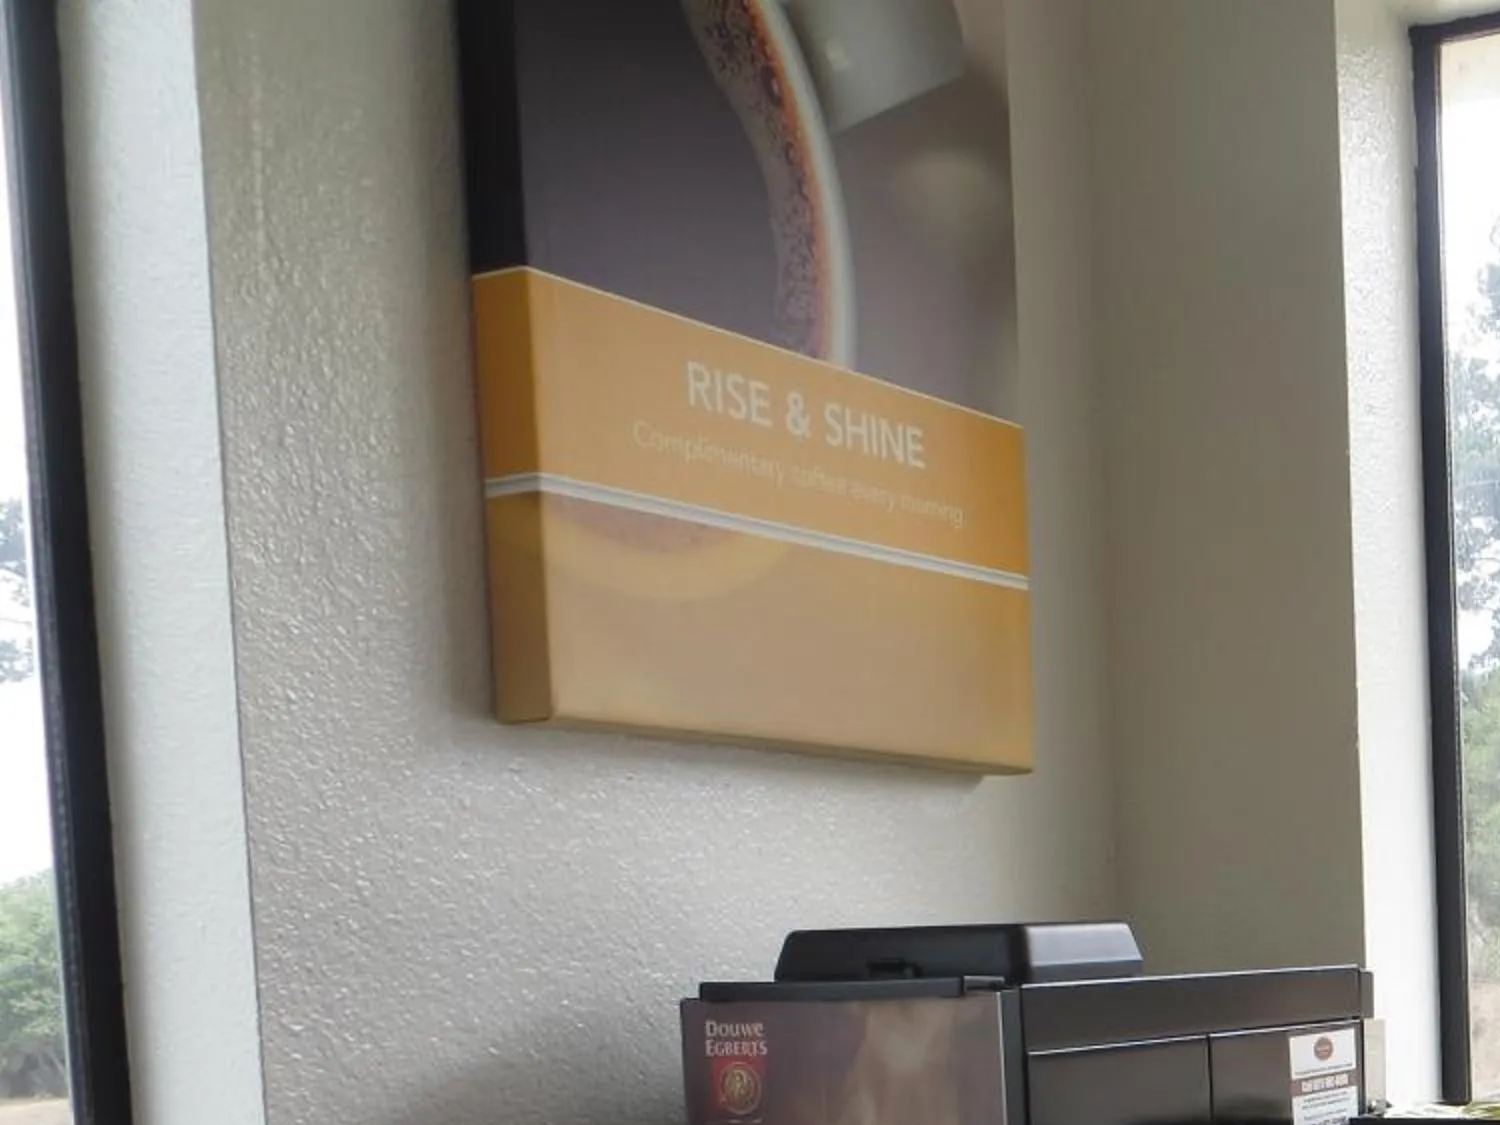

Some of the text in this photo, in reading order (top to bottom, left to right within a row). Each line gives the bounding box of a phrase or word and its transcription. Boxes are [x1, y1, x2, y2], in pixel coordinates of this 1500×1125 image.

[687, 360, 926, 469] RISE & SHINE
[633, 420, 785, 487] Complimentary
[705, 1038, 768, 1057] EGBERTS
